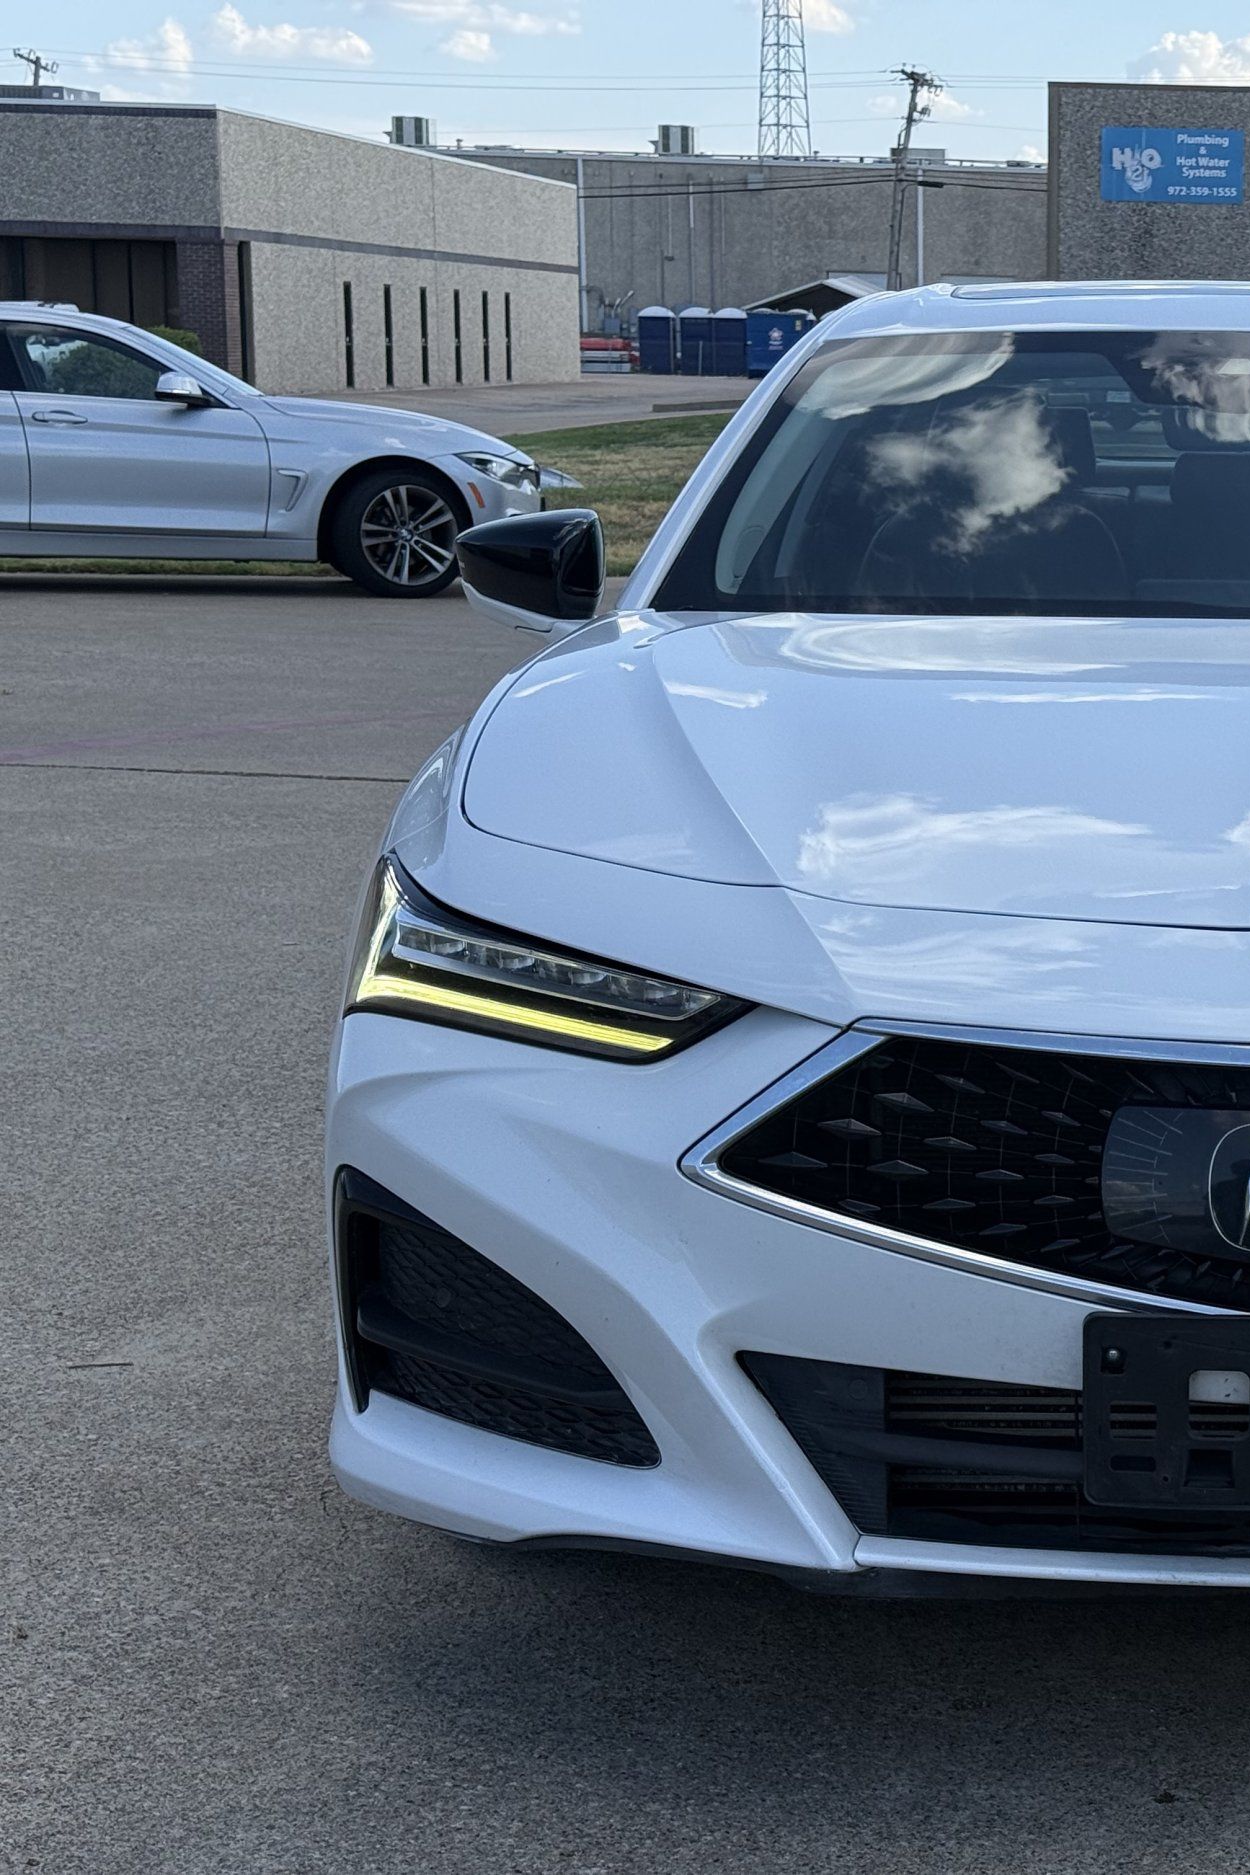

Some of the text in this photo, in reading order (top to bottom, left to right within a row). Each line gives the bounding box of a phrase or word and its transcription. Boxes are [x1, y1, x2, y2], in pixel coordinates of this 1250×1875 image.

[1177, 134, 1230, 148] Plumbing
[1199, 146, 1207, 155] &
[1176, 156, 1230, 167] Hot Water
[1182, 167, 1227, 179] Systems
[1167, 186, 1237, 197] 972-359-1555
